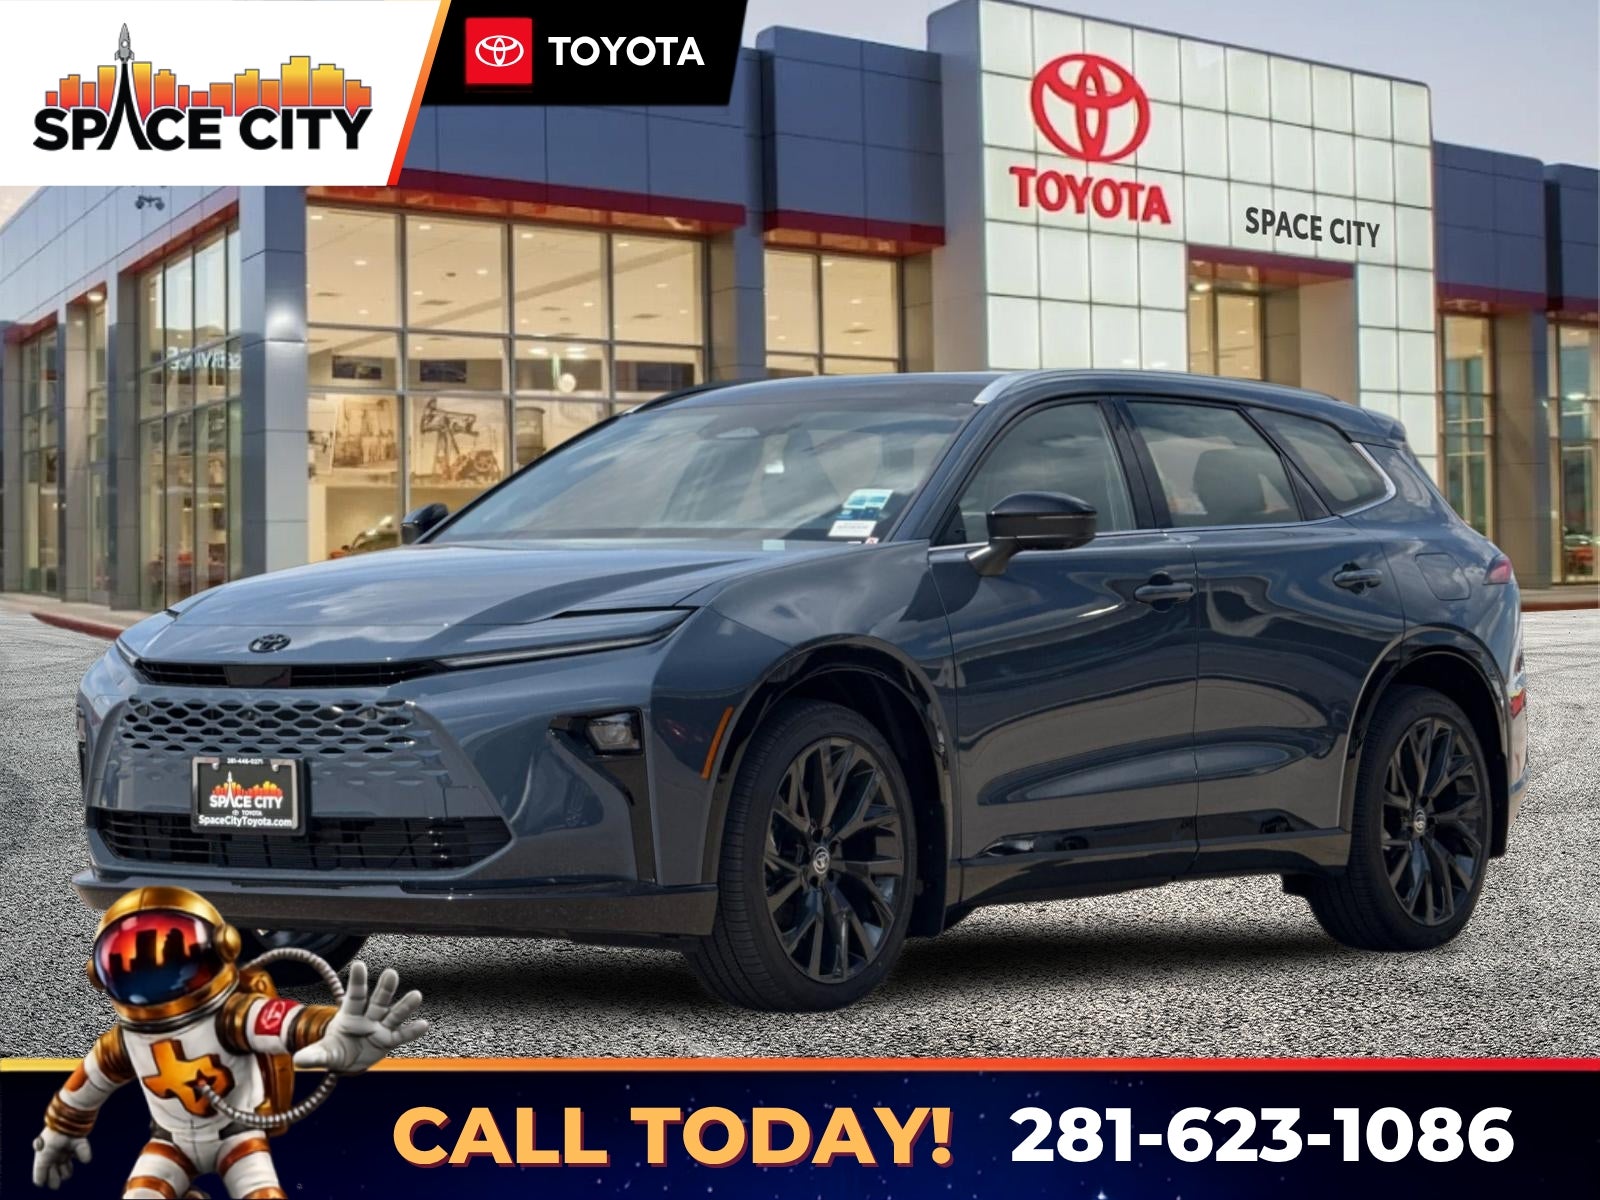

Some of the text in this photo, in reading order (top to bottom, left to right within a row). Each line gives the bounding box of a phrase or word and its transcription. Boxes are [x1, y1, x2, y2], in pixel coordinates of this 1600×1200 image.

[1008, 165, 1172, 225] TOYOTA
[1245, 206, 1381, 248] SPACE CITY
[254, 796, 283, 808] CITY
[198, 815, 292, 827] SpaceCityToyota.com
